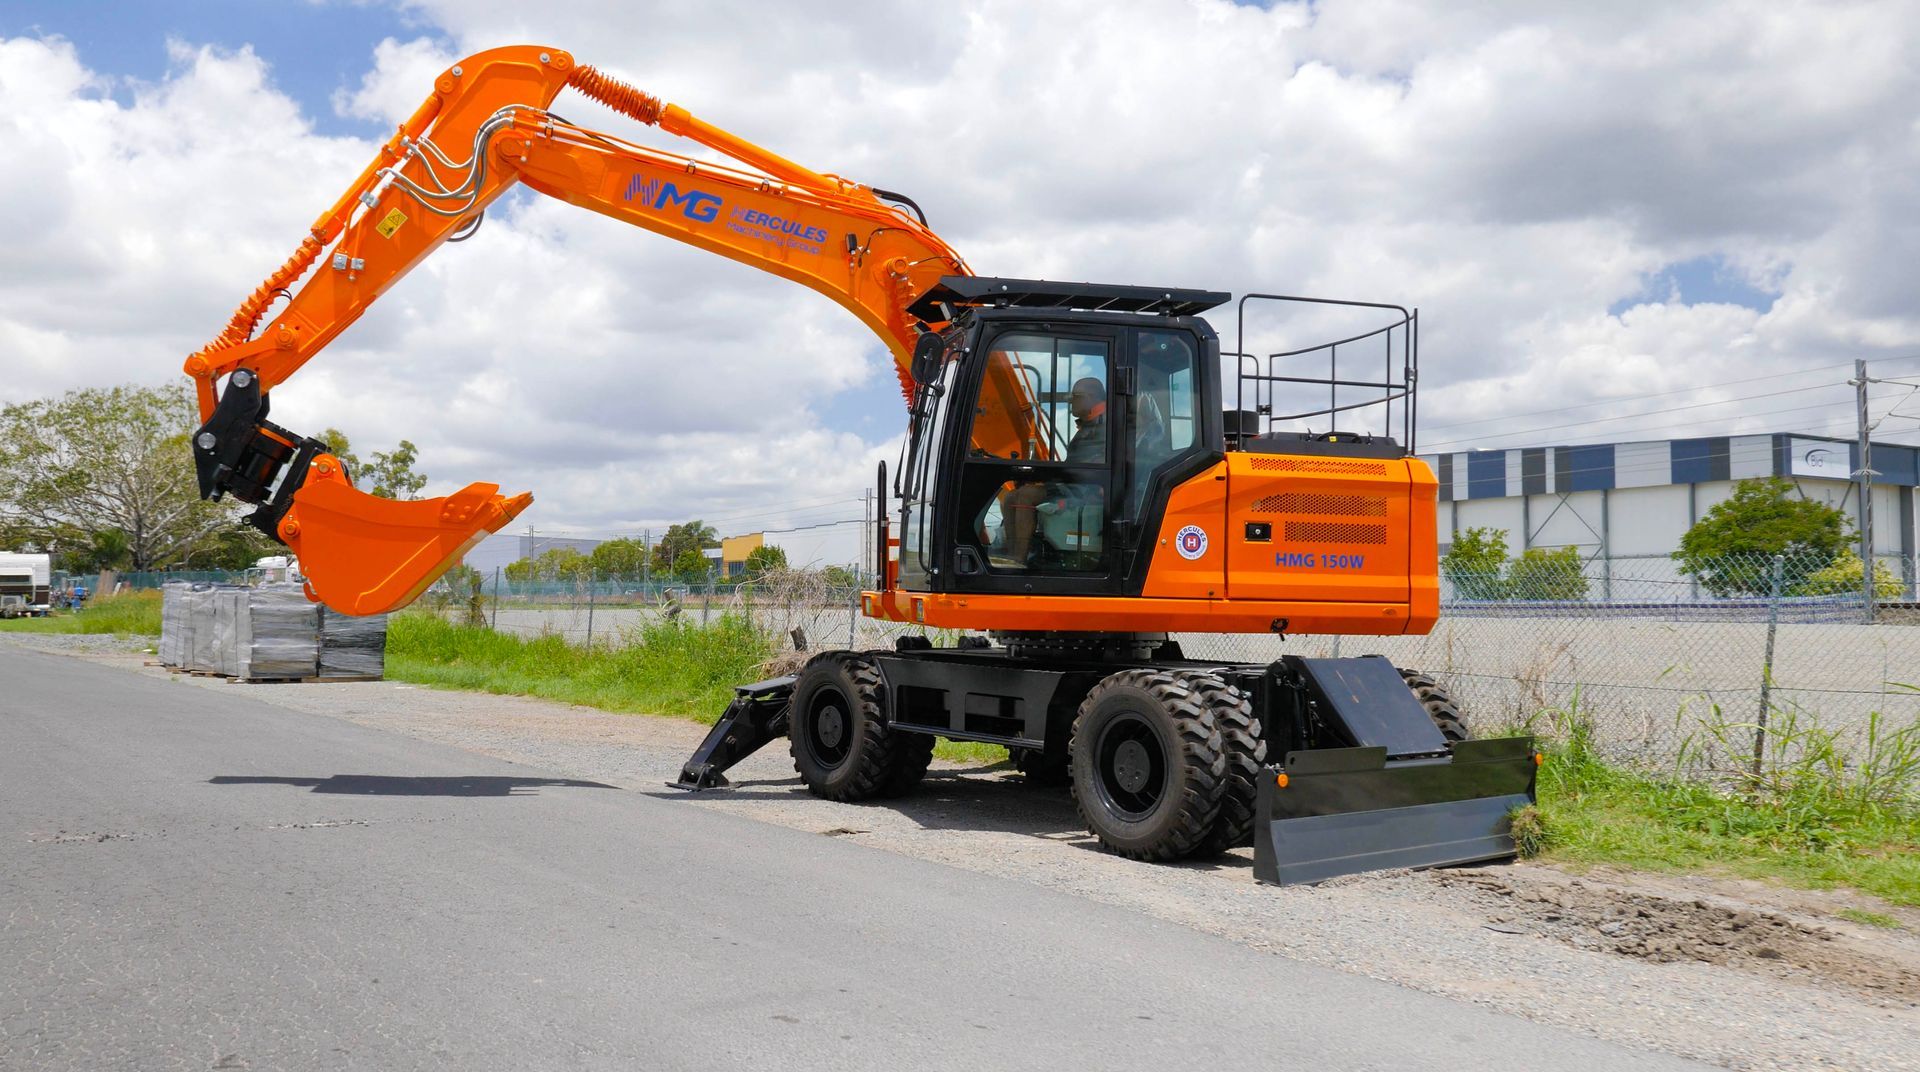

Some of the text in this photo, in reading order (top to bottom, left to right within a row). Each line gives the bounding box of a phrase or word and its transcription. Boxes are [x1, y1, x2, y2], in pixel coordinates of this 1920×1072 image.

[730, 205, 828, 243] HERCULES
[1177, 526, 1207, 543] HERCULES
[1187, 537, 1197, 547] H
[1275, 552, 1365, 569] HMG 150W
